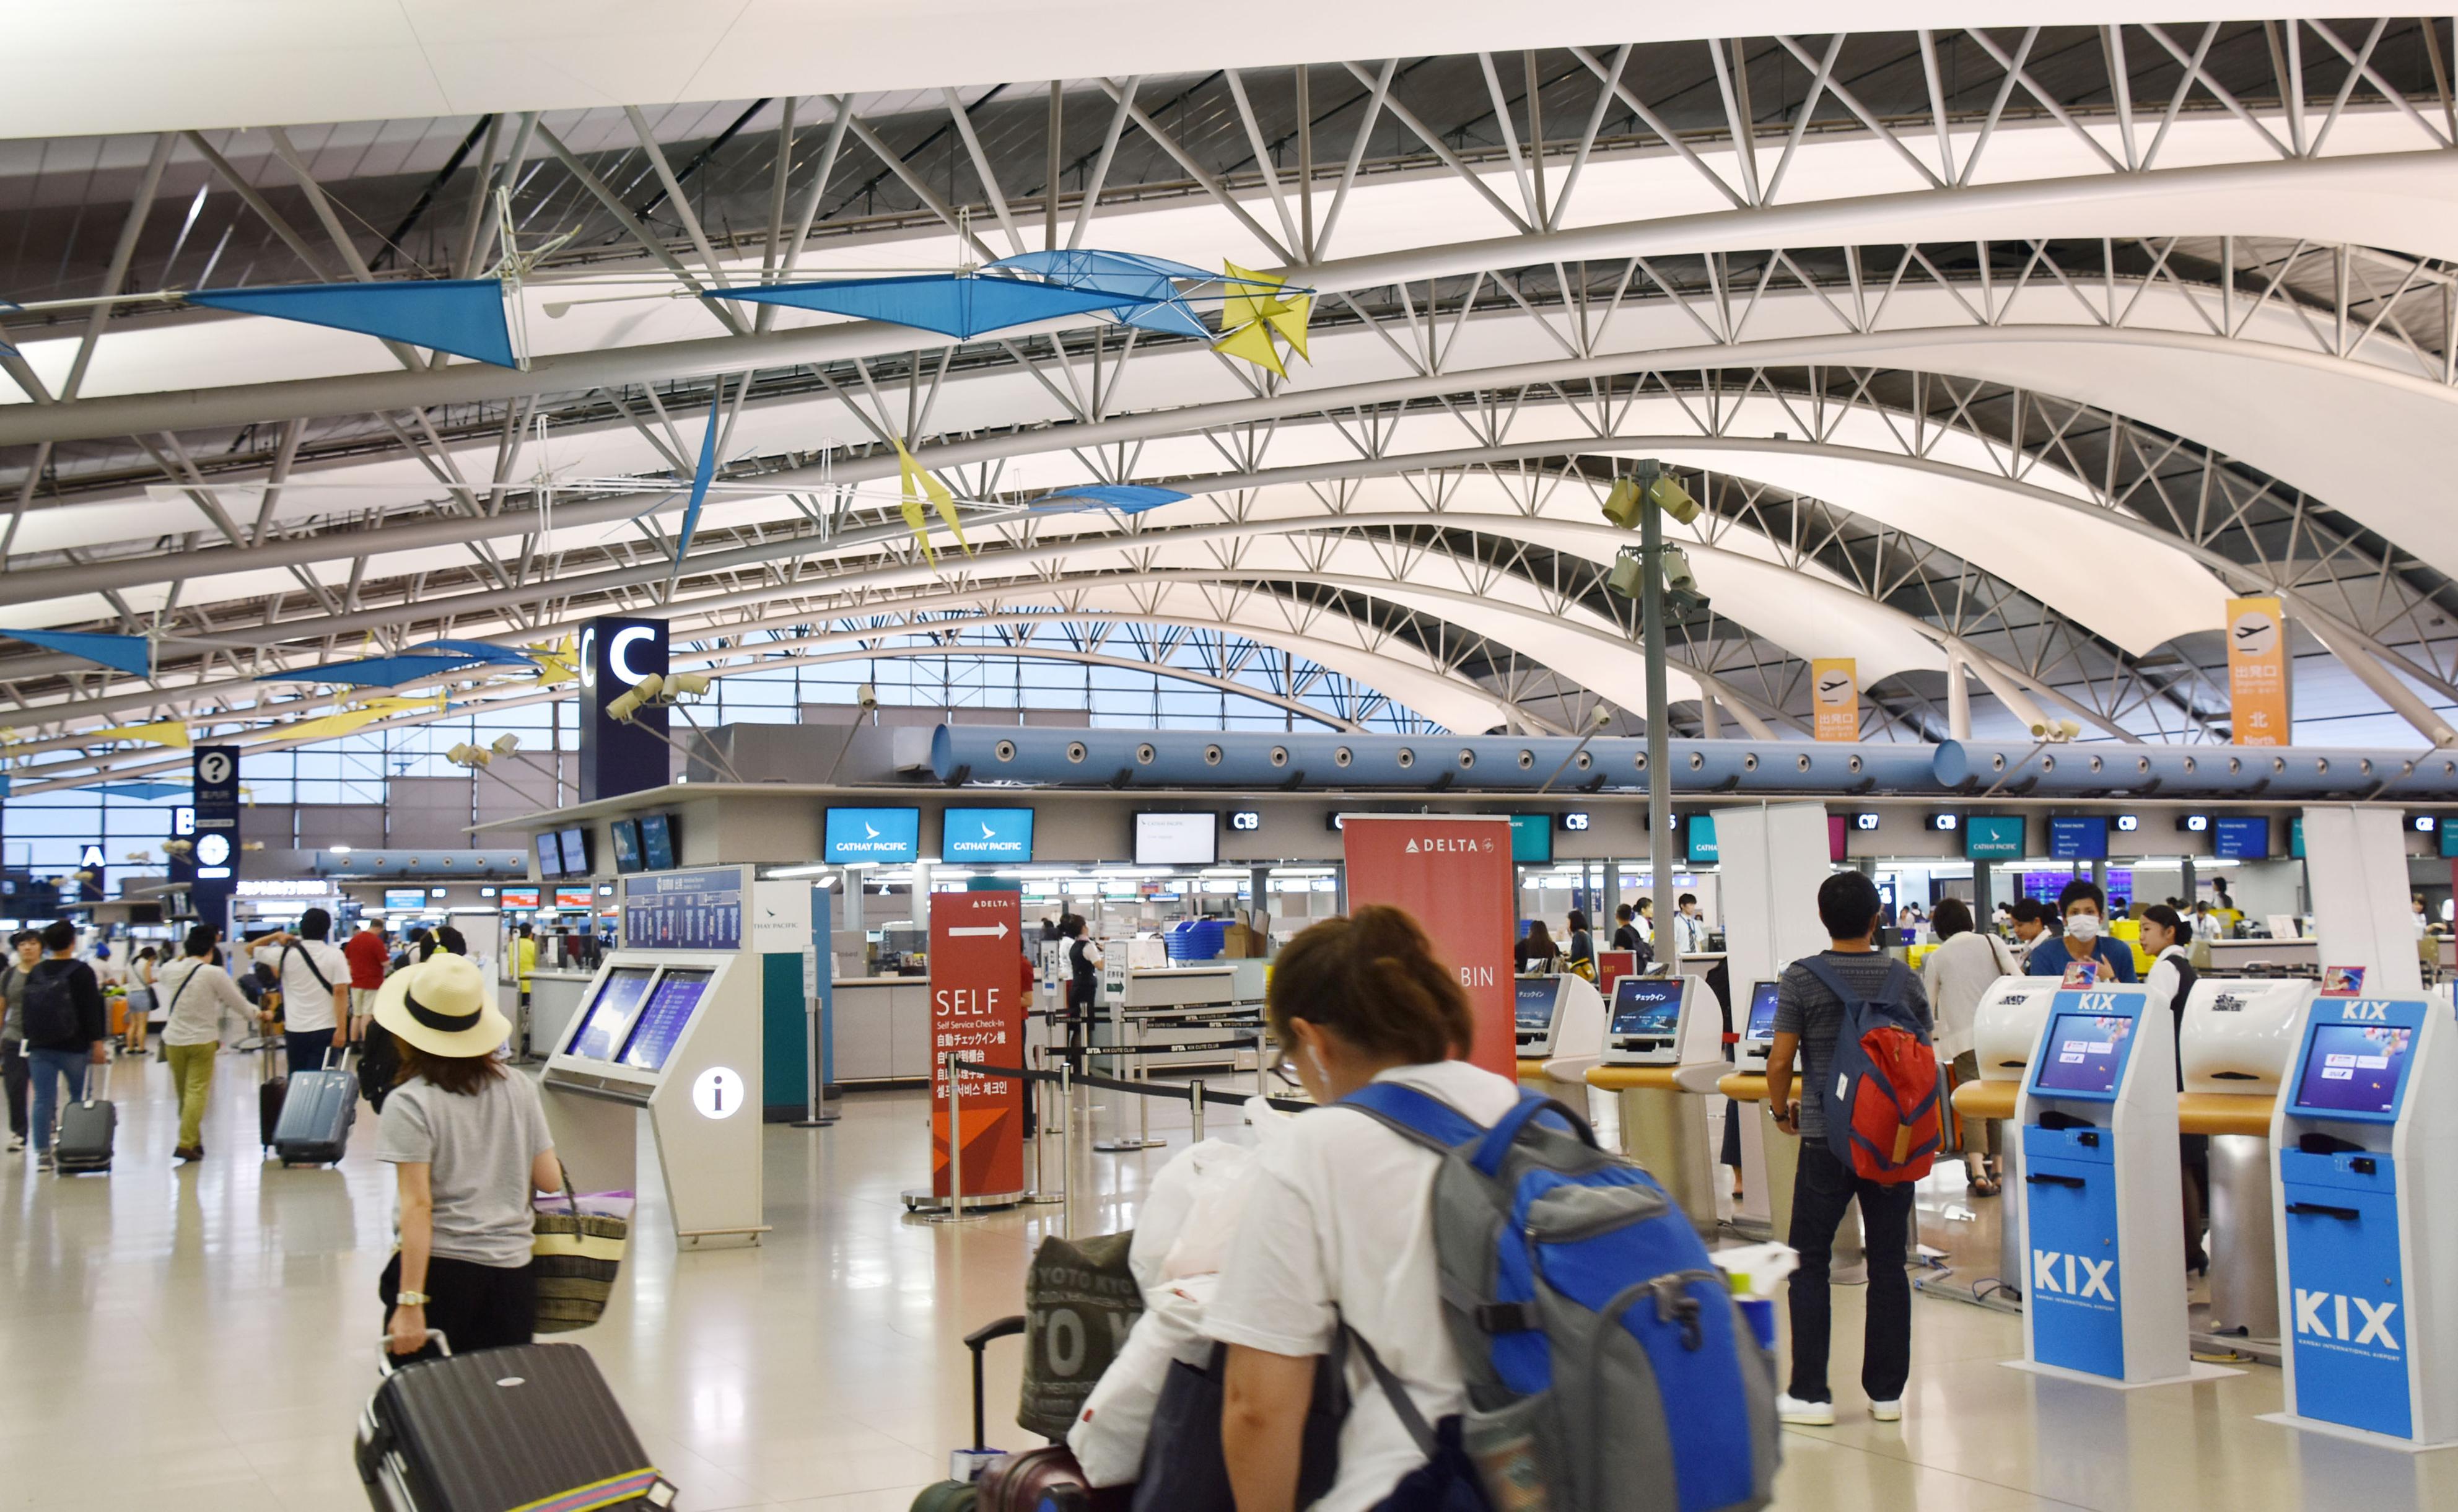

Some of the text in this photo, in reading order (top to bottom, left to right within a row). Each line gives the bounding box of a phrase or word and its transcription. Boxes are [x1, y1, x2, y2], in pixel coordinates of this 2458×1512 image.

[610, 626, 655, 686] C
[1819, 714, 1853, 723] 出発口
[2249, 711, 2269, 728] 北
[2244, 735, 2276, 745] North
[1233, 813, 1258, 829] C13
[1566, 814, 1588, 829] C15
[1858, 815, 1878, 829] C17
[836, 842, 907, 850] CATHAY PACIFIC
[953, 842, 989, 850] CATHAY
[1424, 839, 1477, 852] DELTA
[81, 846, 106, 867] A
[1456, 966, 1494, 987] BIN
[936, 988, 999, 1016] SELF
[2078, 993, 2117, 1010] KIX
[2342, 1000, 2390, 1021] KIX
[937, 1019, 1005, 1029] Self Service Check-In
[937, 1031, 1006, 1047] 自動チェックイン機
[937, 1049, 985, 1064] 自到櫃台
[984, 1080, 1007, 1096] 체크인
[1037, 1267, 1091, 1289] YOTO
[2034, 1249, 2115, 1301] KIX
[2294, 1288, 2400, 1351] KIX
[2298, 1339, 2400, 1361] KANSAI INTERNATIONAL AIRPORT
